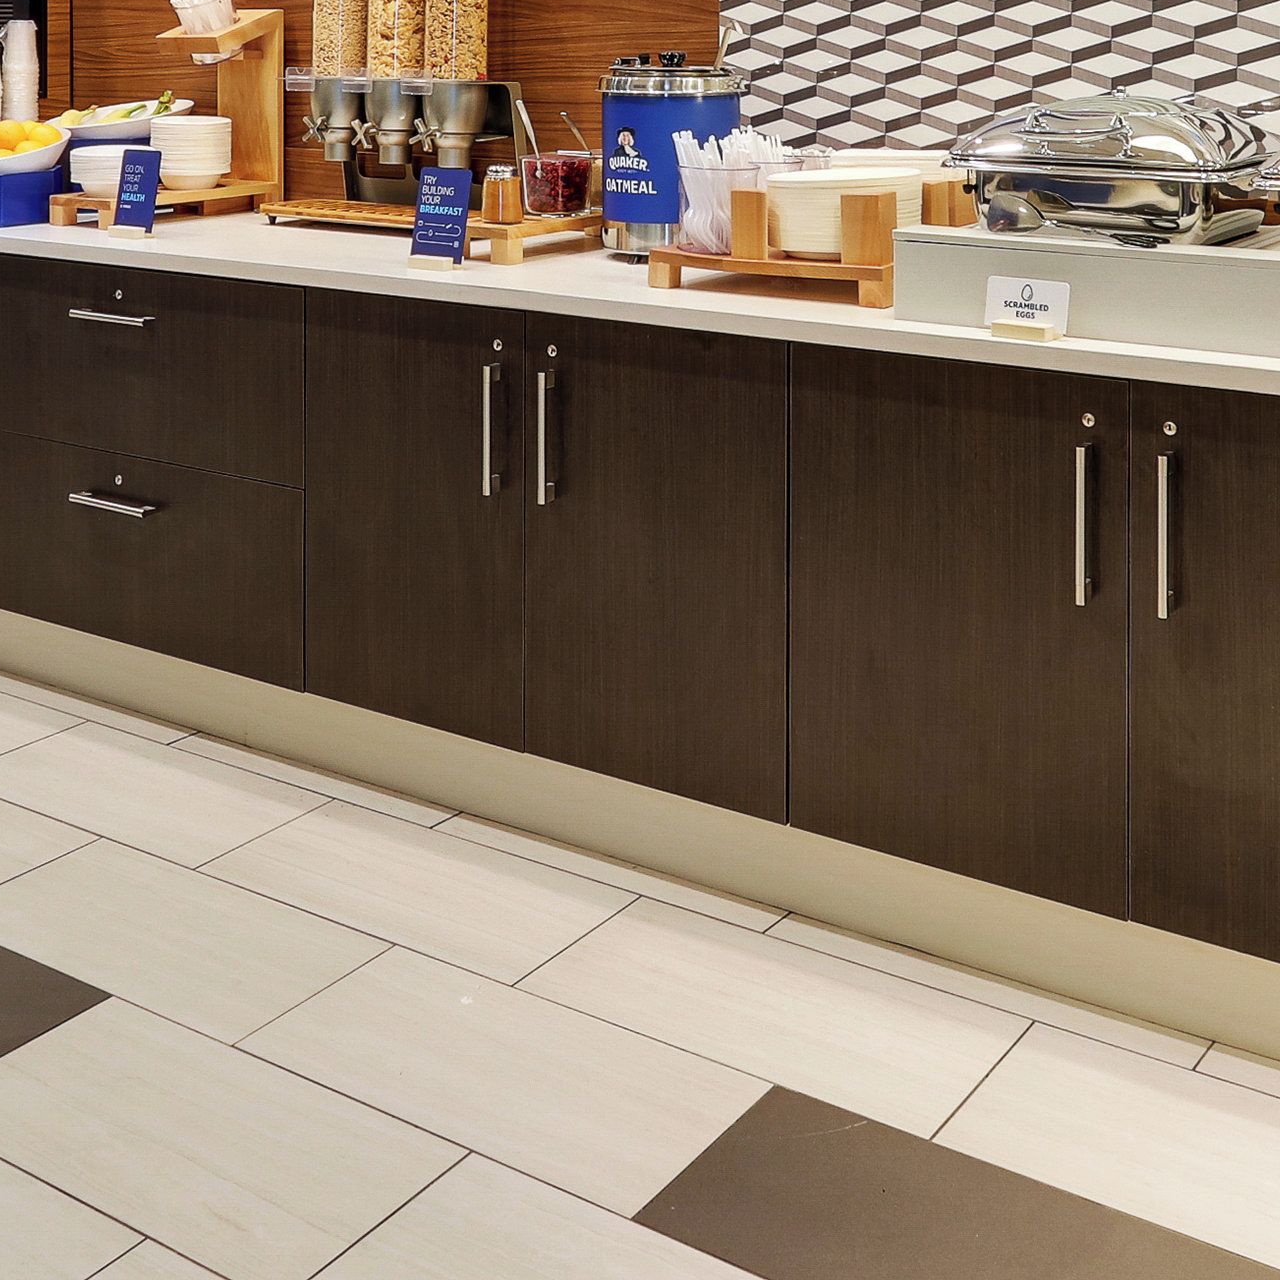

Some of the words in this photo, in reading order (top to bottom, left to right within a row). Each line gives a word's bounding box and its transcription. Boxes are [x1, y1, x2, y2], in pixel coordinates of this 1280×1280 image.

[609, 156, 649, 172] QUAKER
[423, 175, 437, 185] TRY
[422, 185, 455, 196] BUILDING
[605, 177, 658, 195] OATMEAL
[121, 192, 146, 202] HEALTH
[421, 195, 441, 204] YOUR
[419, 204, 464, 217] BREAKFAST
[1003, 300, 1049, 312] SCRAMBLED
[1015, 310, 1036, 319] EGGS
